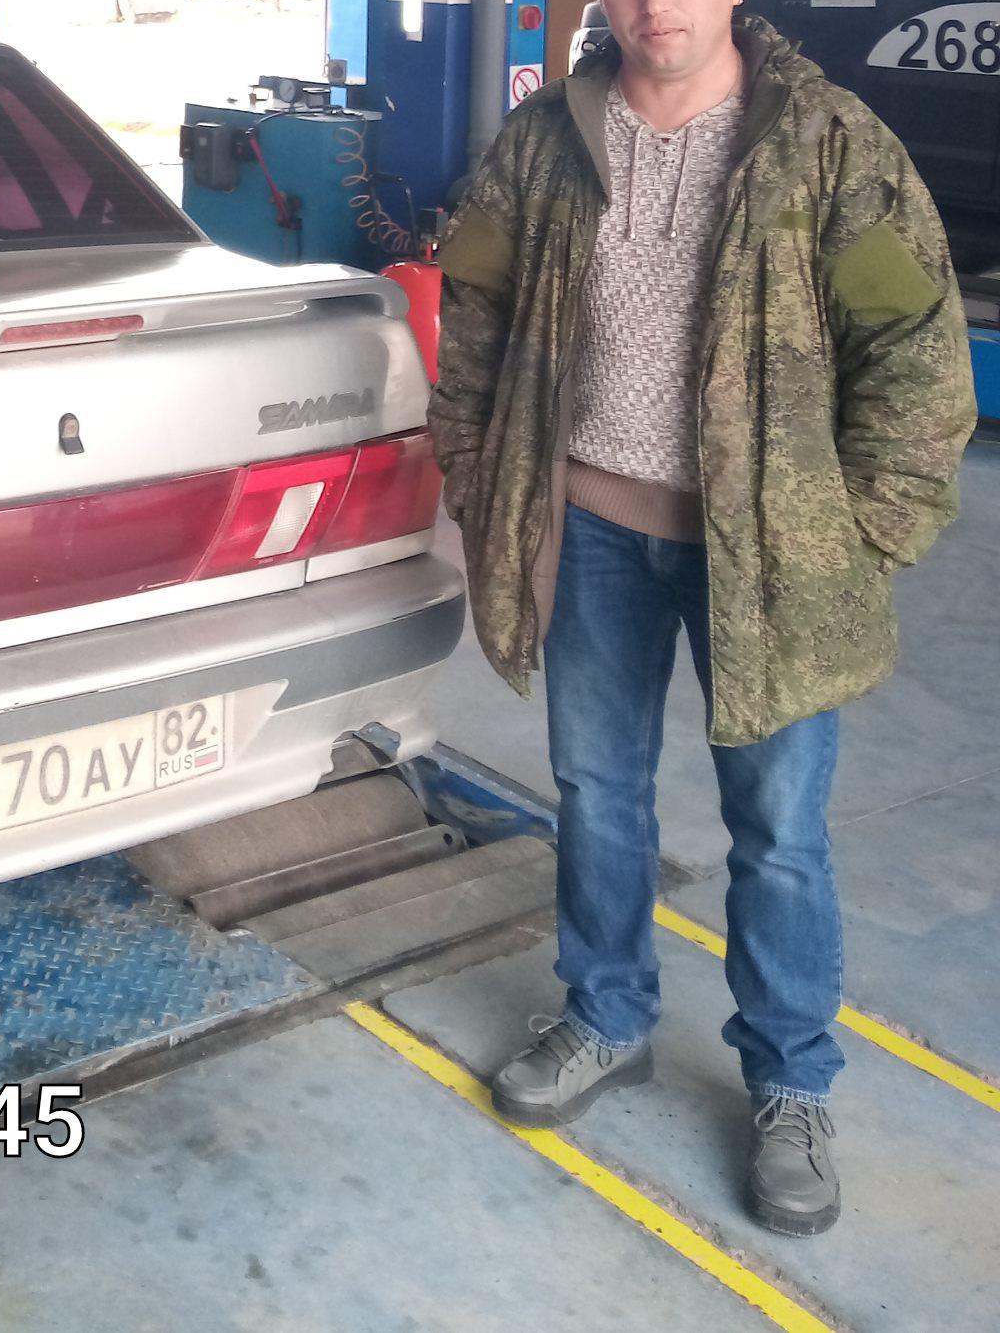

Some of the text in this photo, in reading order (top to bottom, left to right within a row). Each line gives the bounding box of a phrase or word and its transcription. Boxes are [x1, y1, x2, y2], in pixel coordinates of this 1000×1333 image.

[898, 18, 1000, 73] 268
[161, 703, 208, 756] 82
[158, 754, 193, 778] RUS
